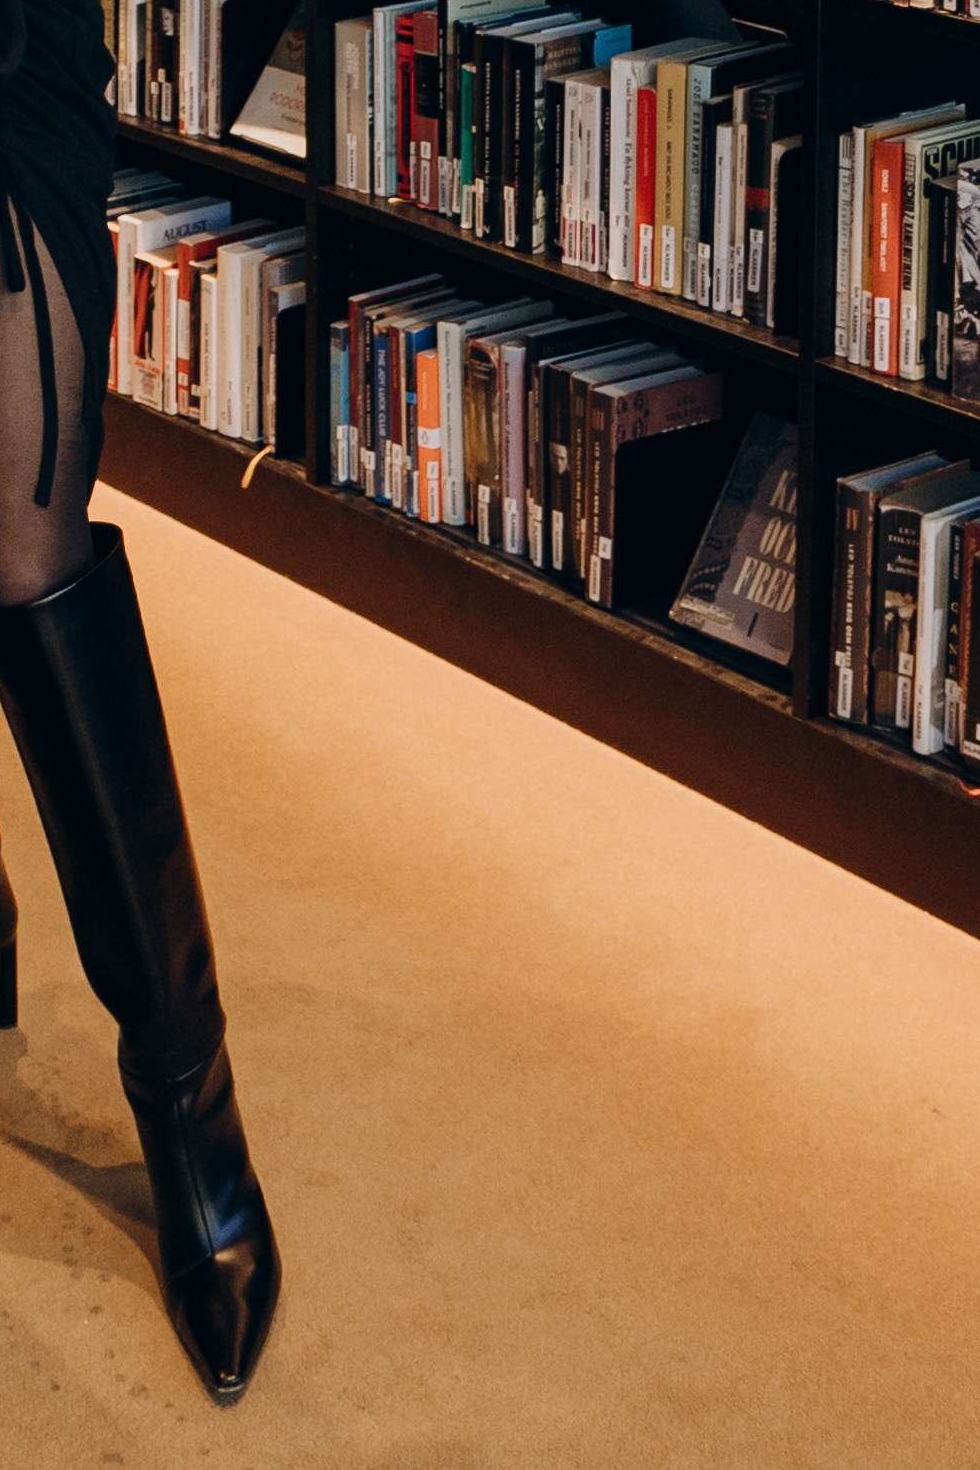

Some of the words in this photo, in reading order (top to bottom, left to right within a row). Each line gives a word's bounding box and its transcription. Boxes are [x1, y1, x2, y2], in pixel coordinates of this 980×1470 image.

[692, 80, 702, 106] JOSÉ
[624, 143, 631, 154] En
[692, 111, 700, 175] SARAMAGO
[841, 174, 850, 195] The
[163, 220, 208, 240] AUGUST
[841, 201, 849, 236] Reader
[751, 248, 759, 286] KLASSIKER
[378, 349, 386, 366] THE
[378, 368, 386, 386] JOY
[378, 388, 386, 411] LUCK
[846, 564, 855, 601] TOLSTOJ
